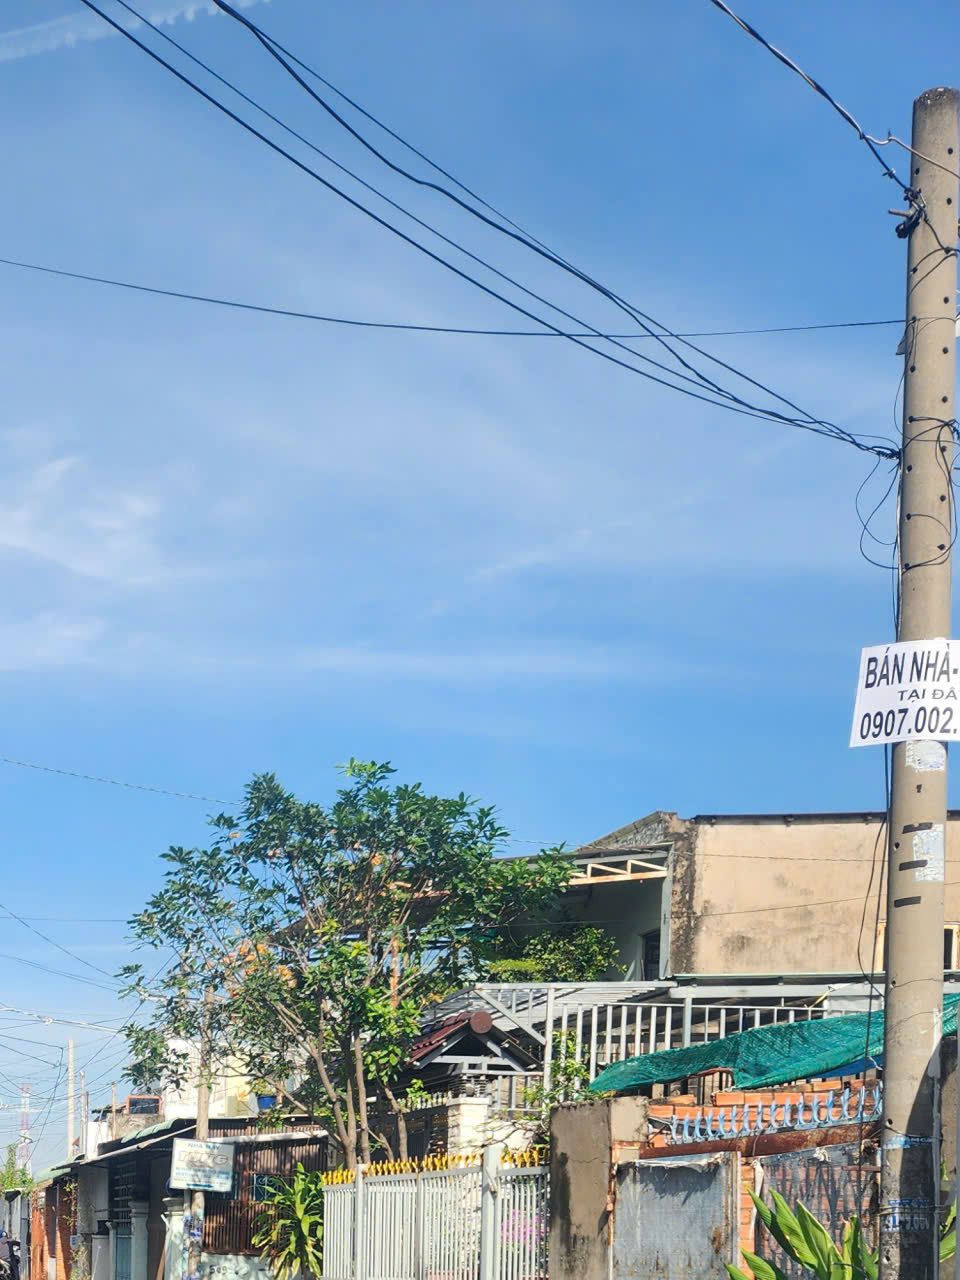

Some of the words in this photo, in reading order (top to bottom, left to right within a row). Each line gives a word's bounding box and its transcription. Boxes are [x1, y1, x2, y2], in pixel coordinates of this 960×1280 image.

[865, 646, 906, 689] BÁN
[897, 688, 926, 703] TẠI
[931, 686, 960, 701] ĐÂ
